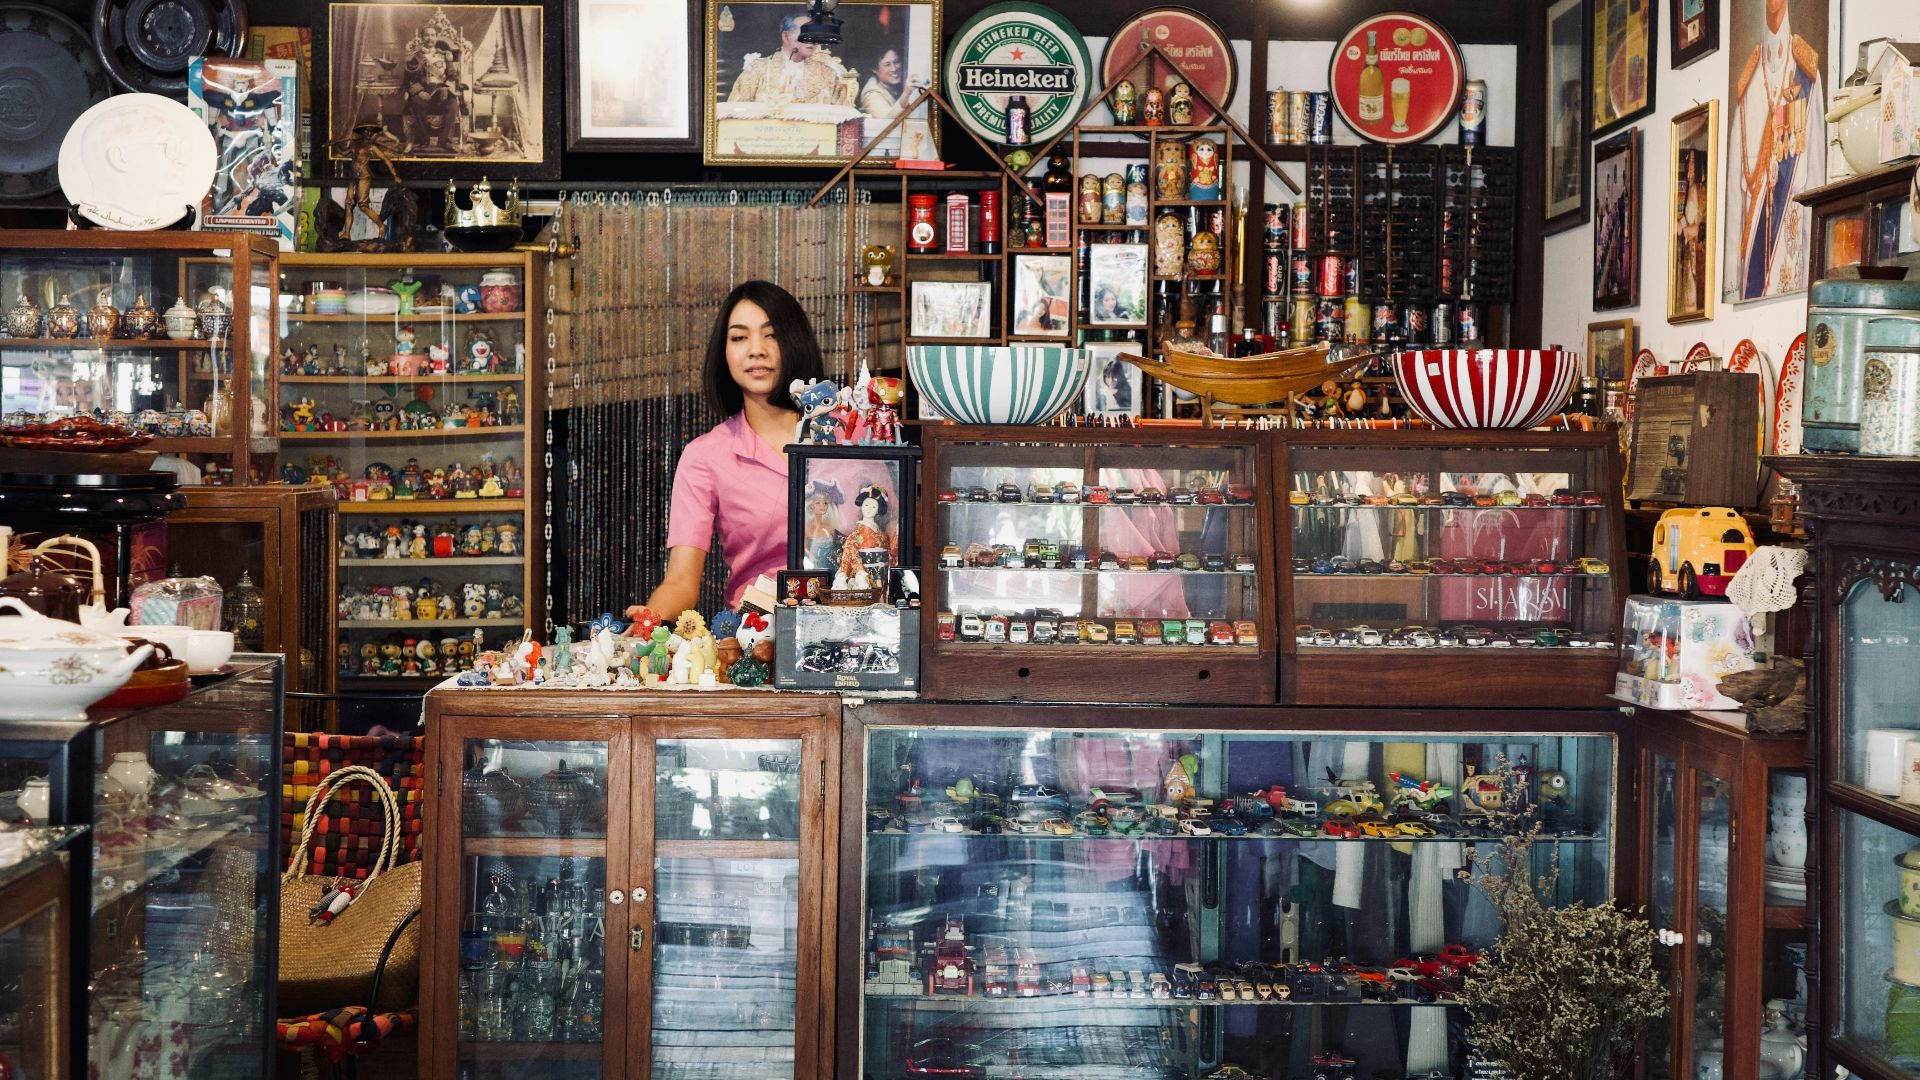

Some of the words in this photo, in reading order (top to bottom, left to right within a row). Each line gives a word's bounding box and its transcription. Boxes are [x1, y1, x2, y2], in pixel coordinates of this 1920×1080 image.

[975, 26, 1030, 54] HEINEKEN
[1033, 31, 1060, 55] BEER
[965, 68, 1069, 88] Heineken
[973, 102, 1006, 130] PREMIU
